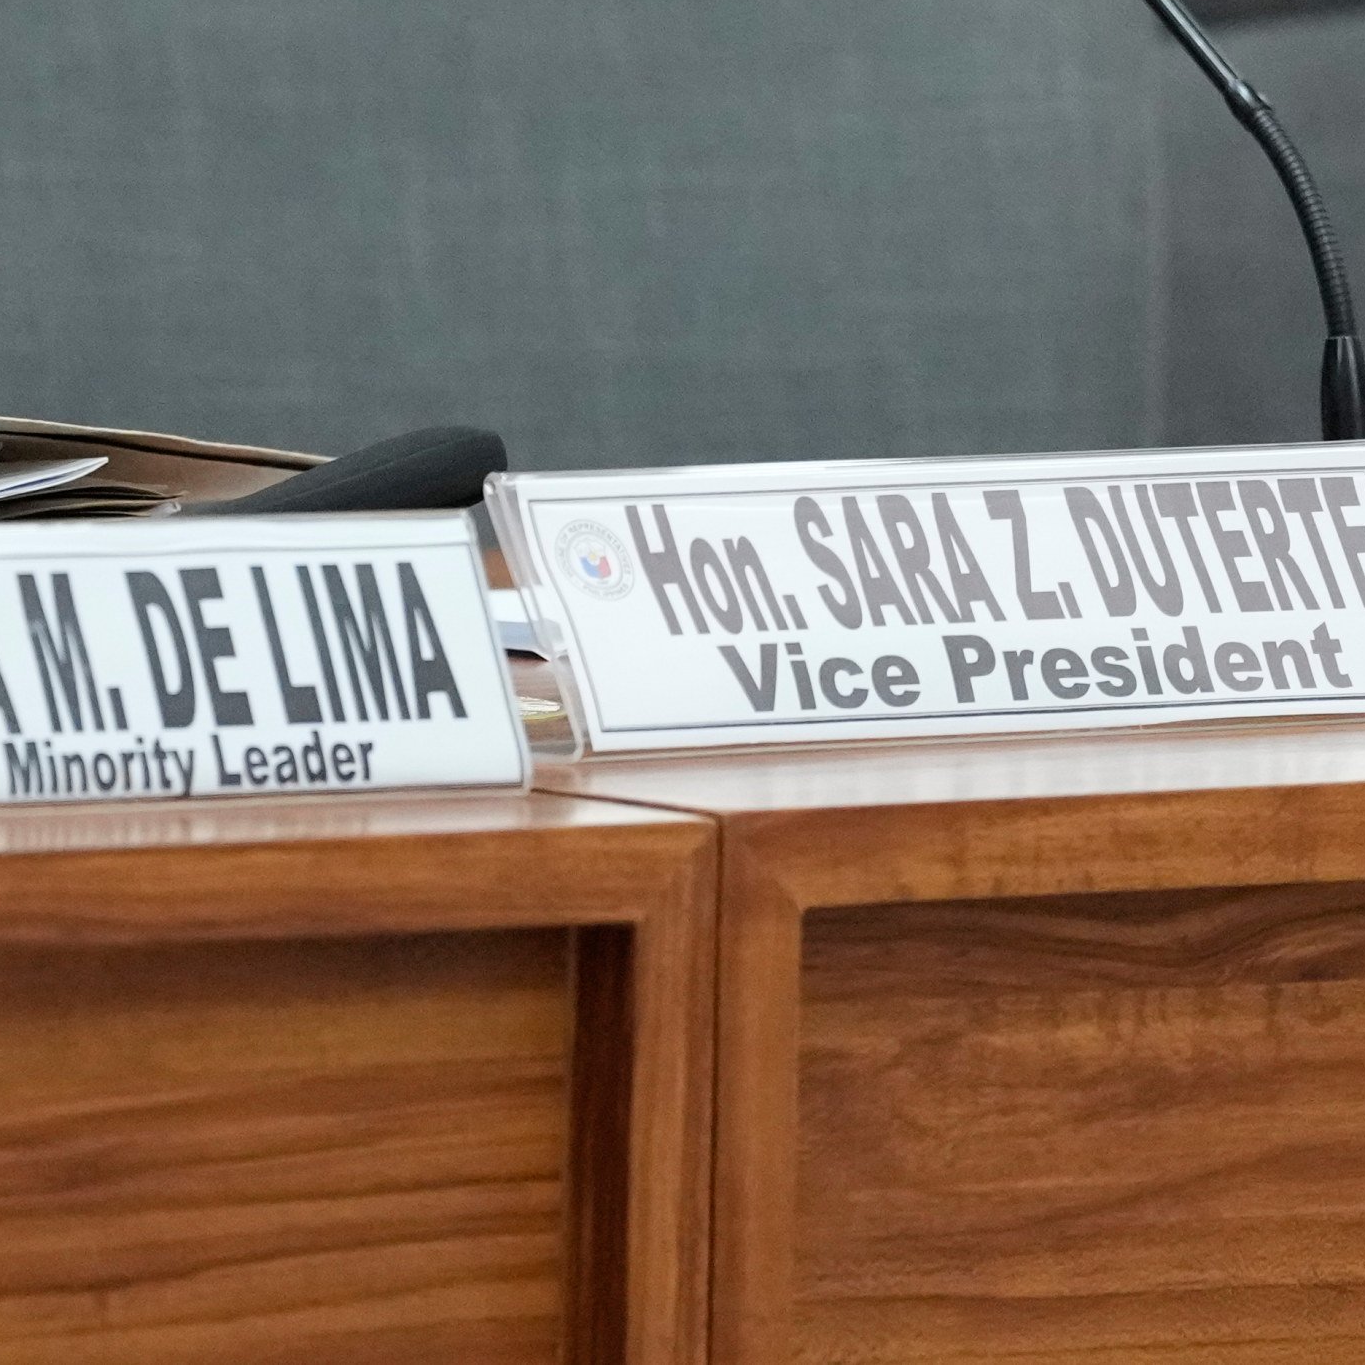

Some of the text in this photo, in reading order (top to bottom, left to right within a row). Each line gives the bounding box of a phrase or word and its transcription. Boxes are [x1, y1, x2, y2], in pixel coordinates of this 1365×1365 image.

[626, 503, 808, 635] Hon.
[794, 492, 1007, 630] SARA
[983, 489, 1082, 621] Z.
[17, 571, 128, 733] M.
[125, 567, 254, 729] DE
[250, 562, 468, 725] LIMA
[718, 622, 1353, 712] Vice President
[3, 735, 194, 799] Minority
[211, 730, 374, 787] Leader
